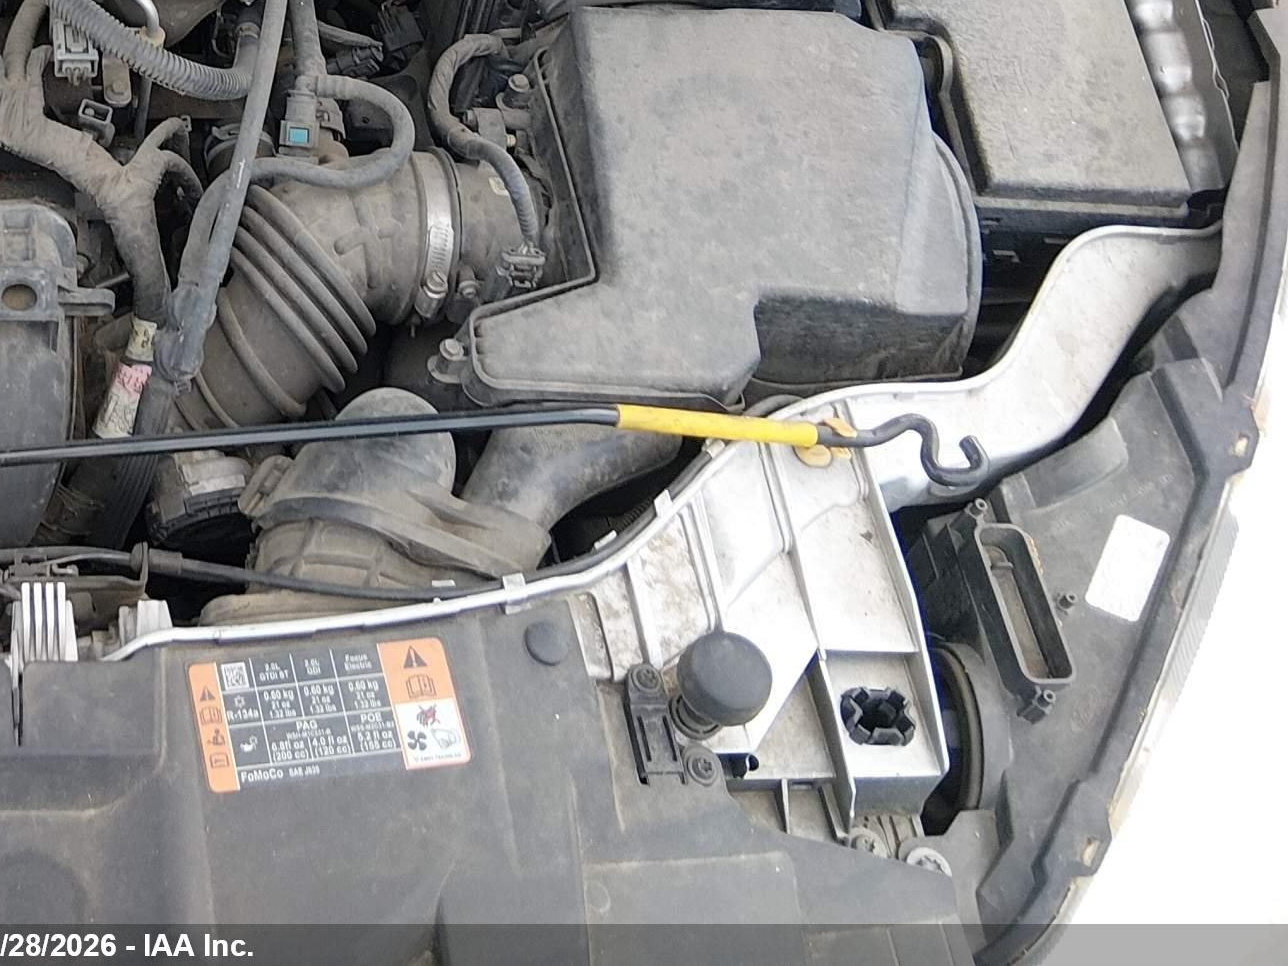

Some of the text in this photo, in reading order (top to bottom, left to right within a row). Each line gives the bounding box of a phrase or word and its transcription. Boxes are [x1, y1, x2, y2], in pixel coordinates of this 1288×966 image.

[345, 654, 368, 662] Focus
[344, 661, 372, 671] Electric
[323, 684, 334, 695] kg
[367, 679, 379, 691] kg
[283, 689, 294, 700] kg
[227, 708, 259, 721] R-134a
[381, 730, 392, 739] oz
[293, 740, 304, 749] oz
[336, 735, 347, 745] oz
[381, 738, 396, 748] cc)
[336, 744, 351, 754] cc)
[273, 748, 308, 762] (200 cc)
[240, 768, 283, 782] FoMoCo
